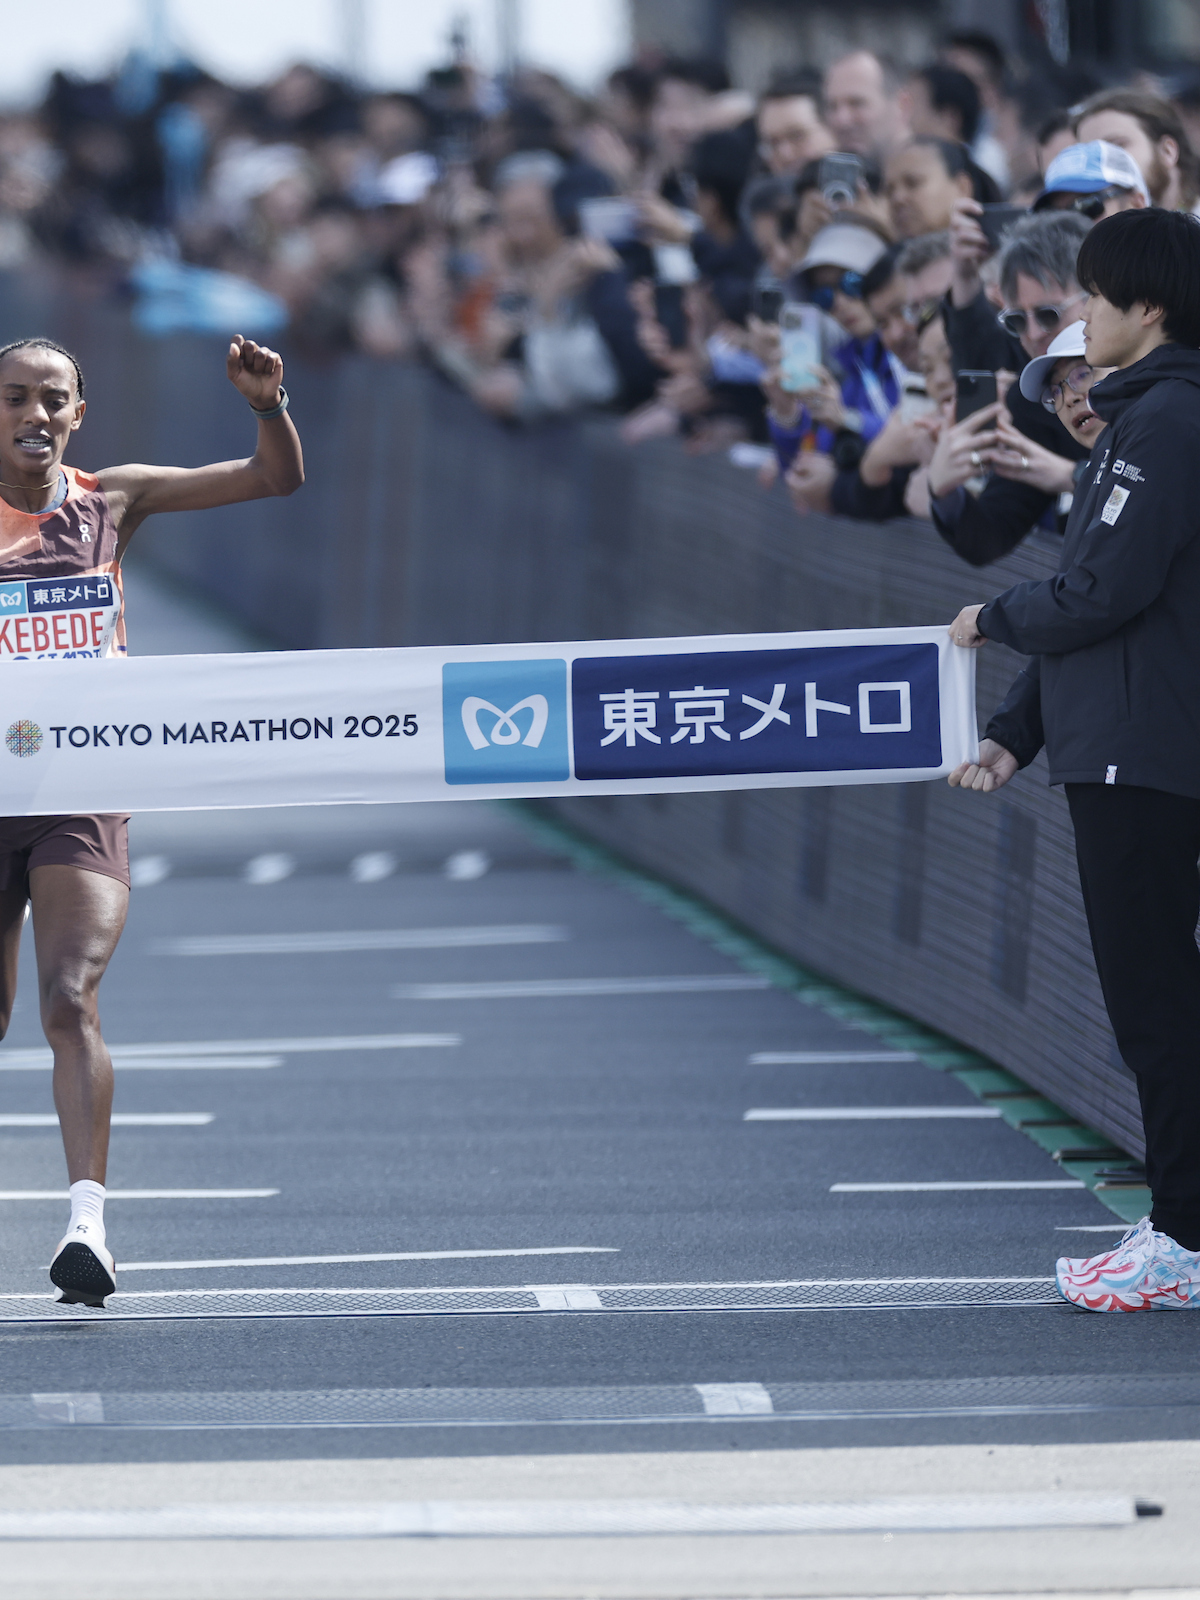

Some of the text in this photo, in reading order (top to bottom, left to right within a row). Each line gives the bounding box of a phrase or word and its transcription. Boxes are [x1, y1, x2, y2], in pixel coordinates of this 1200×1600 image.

[32, 583, 109, 605] 東京メトロ
[49, 713, 420, 749] TOKYO MARATHON 2025
[599, 681, 912, 747] 東京メトロ
